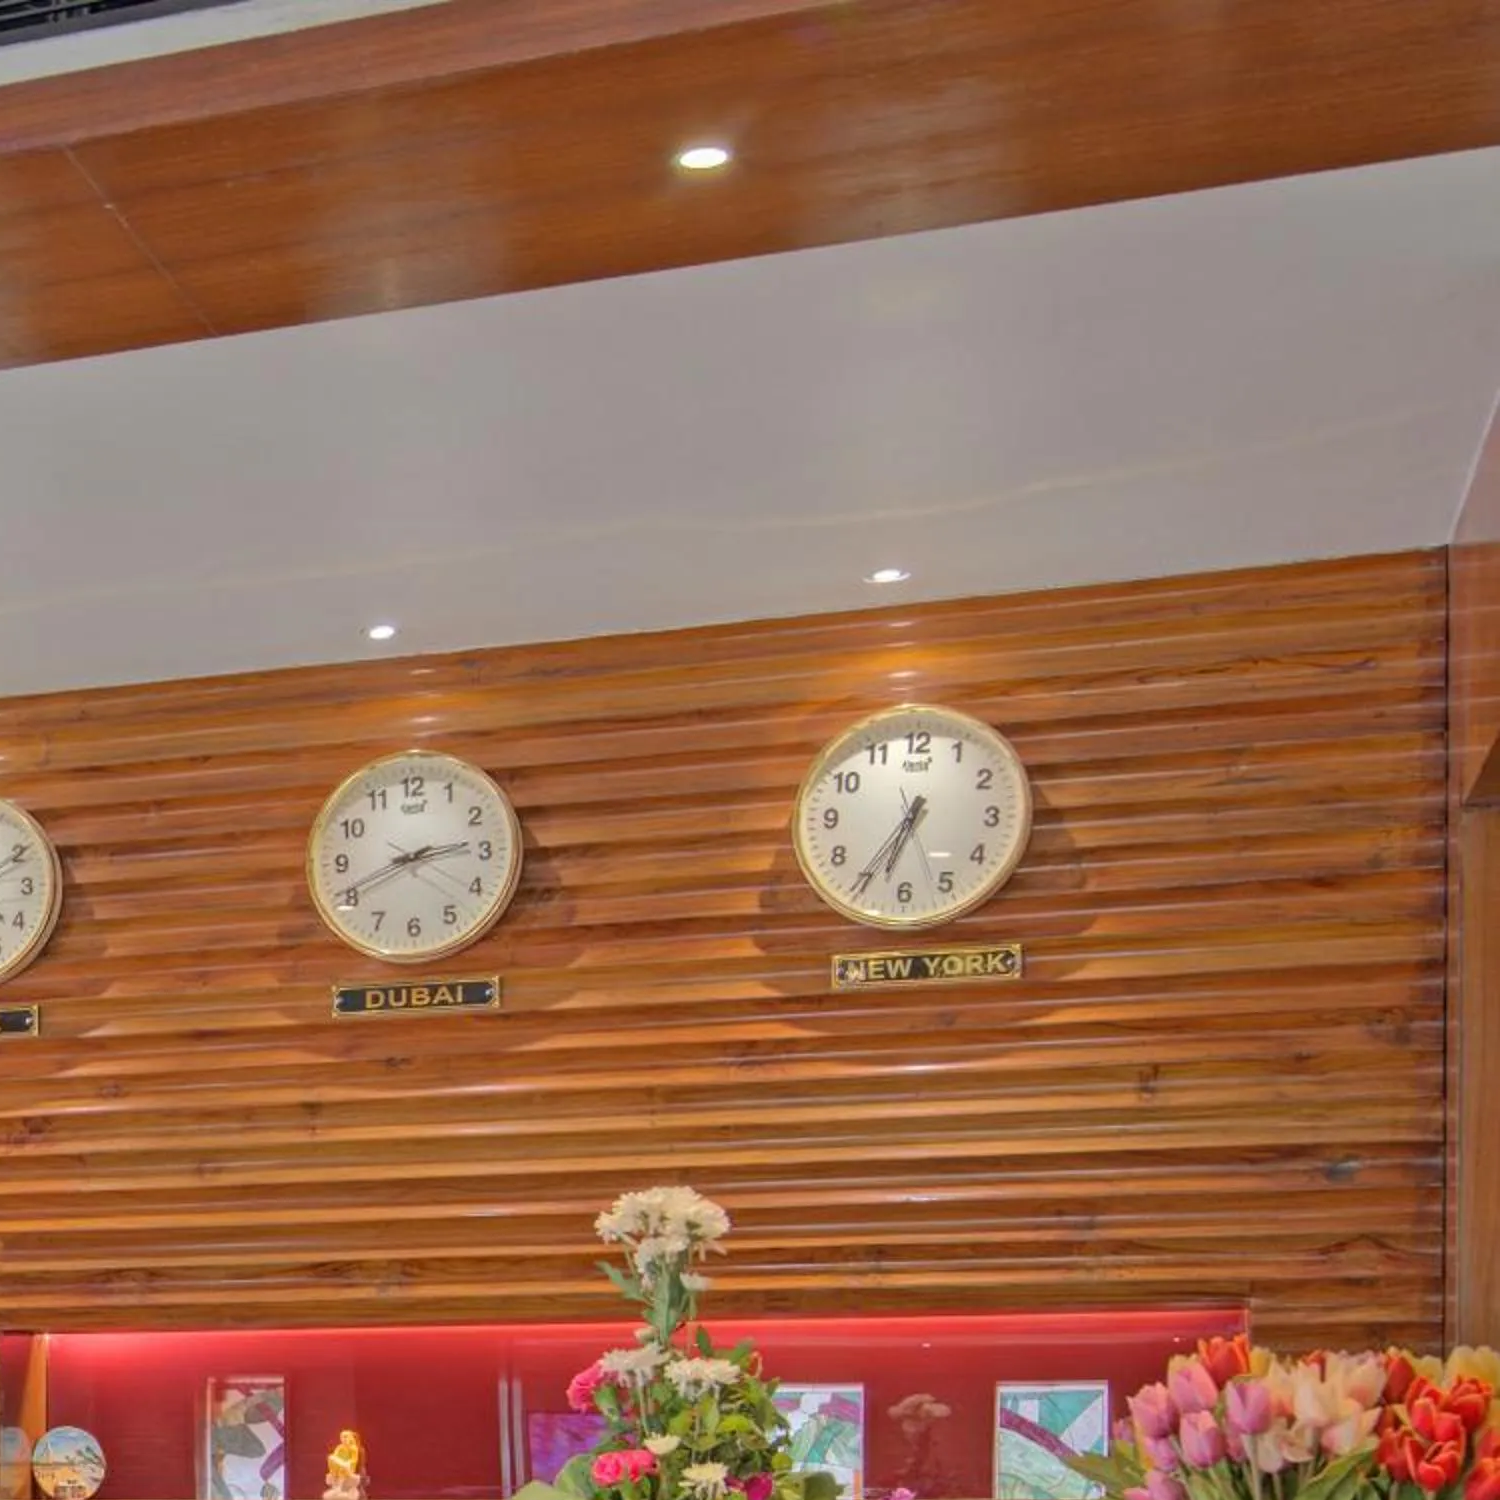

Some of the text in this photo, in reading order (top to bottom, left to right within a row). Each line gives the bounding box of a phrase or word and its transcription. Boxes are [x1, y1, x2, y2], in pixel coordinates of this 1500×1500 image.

[905, 732, 930, 754] 12
[952, 742, 963, 763] 1
[866, 744, 888, 765] 11
[401, 776, 424, 797] 12
[833, 772, 860, 793] 10
[976, 769, 992, 789] 2
[368, 790, 386, 810] 11
[444, 783, 453, 803] 1
[468, 806, 482, 826] 2
[824, 808, 839, 829] 9
[985, 806, 999, 827] 3
[340, 818, 364, 838] 10
[12, 845, 25, 862] 2
[479, 841, 492, 860] 3
[831, 846, 846, 866] 8
[970, 844, 985, 864] 4
[335, 854, 348, 873] 9
[21, 878, 32, 896] 3
[469, 877, 482, 896] 4
[858, 872, 873, 893] 7
[897, 882, 912, 902] 6
[938, 872, 953, 893] 5
[346, 888, 358, 907] 8
[12, 912, 24, 929] 4
[372, 912, 385, 931] 7
[443, 906, 456, 924] 5
[408, 918, 421, 937] 6
[848, 953, 1007, 981] NEW YORK
[365, 985, 463, 1009] DUBAI
